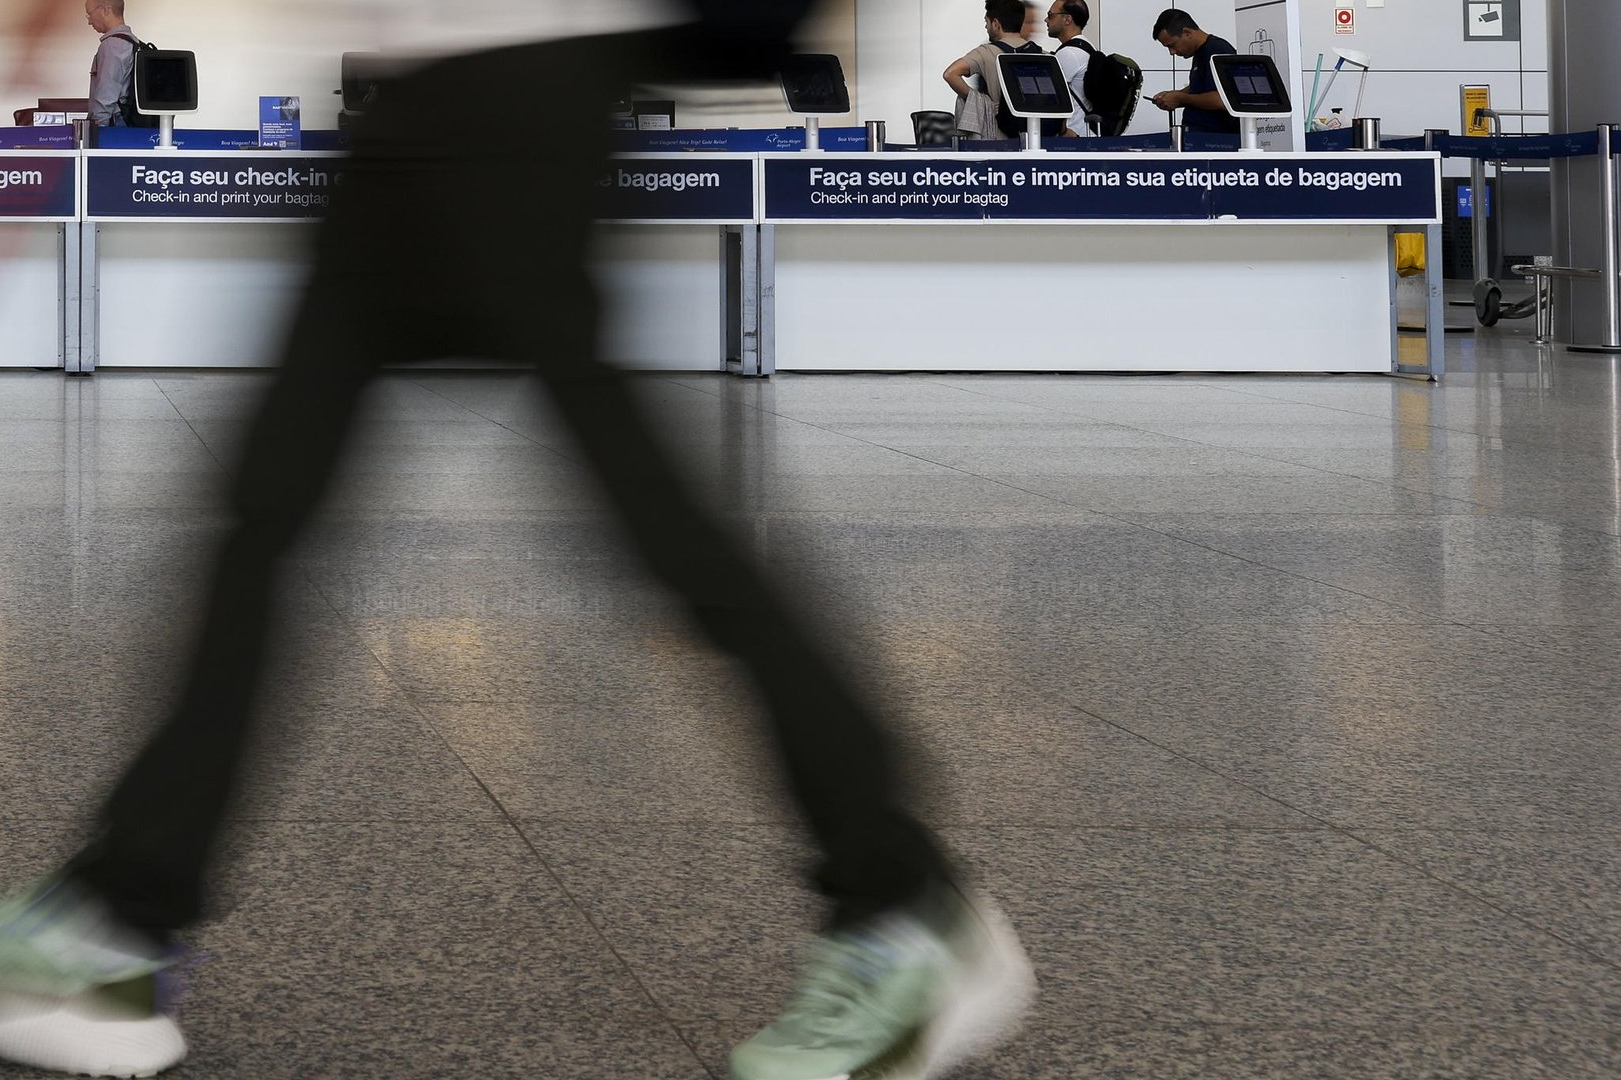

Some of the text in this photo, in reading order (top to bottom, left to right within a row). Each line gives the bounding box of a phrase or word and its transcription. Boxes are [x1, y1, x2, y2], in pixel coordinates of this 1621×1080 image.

[133, 166, 183, 189] Faça
[190, 171, 228, 185] seu
[234, 167, 328, 186] check-in
[618, 168, 720, 191] bagagem
[810, 168, 1401, 190] Faça seu check-in e imprima sua etiqueta de bagagem
[133, 190, 189, 202] Check-in
[194, 191, 217, 202] and
[222, 192, 249, 205] print
[254, 195, 281, 206] your
[811, 189, 1008, 206] Check-in and print your bagtag
